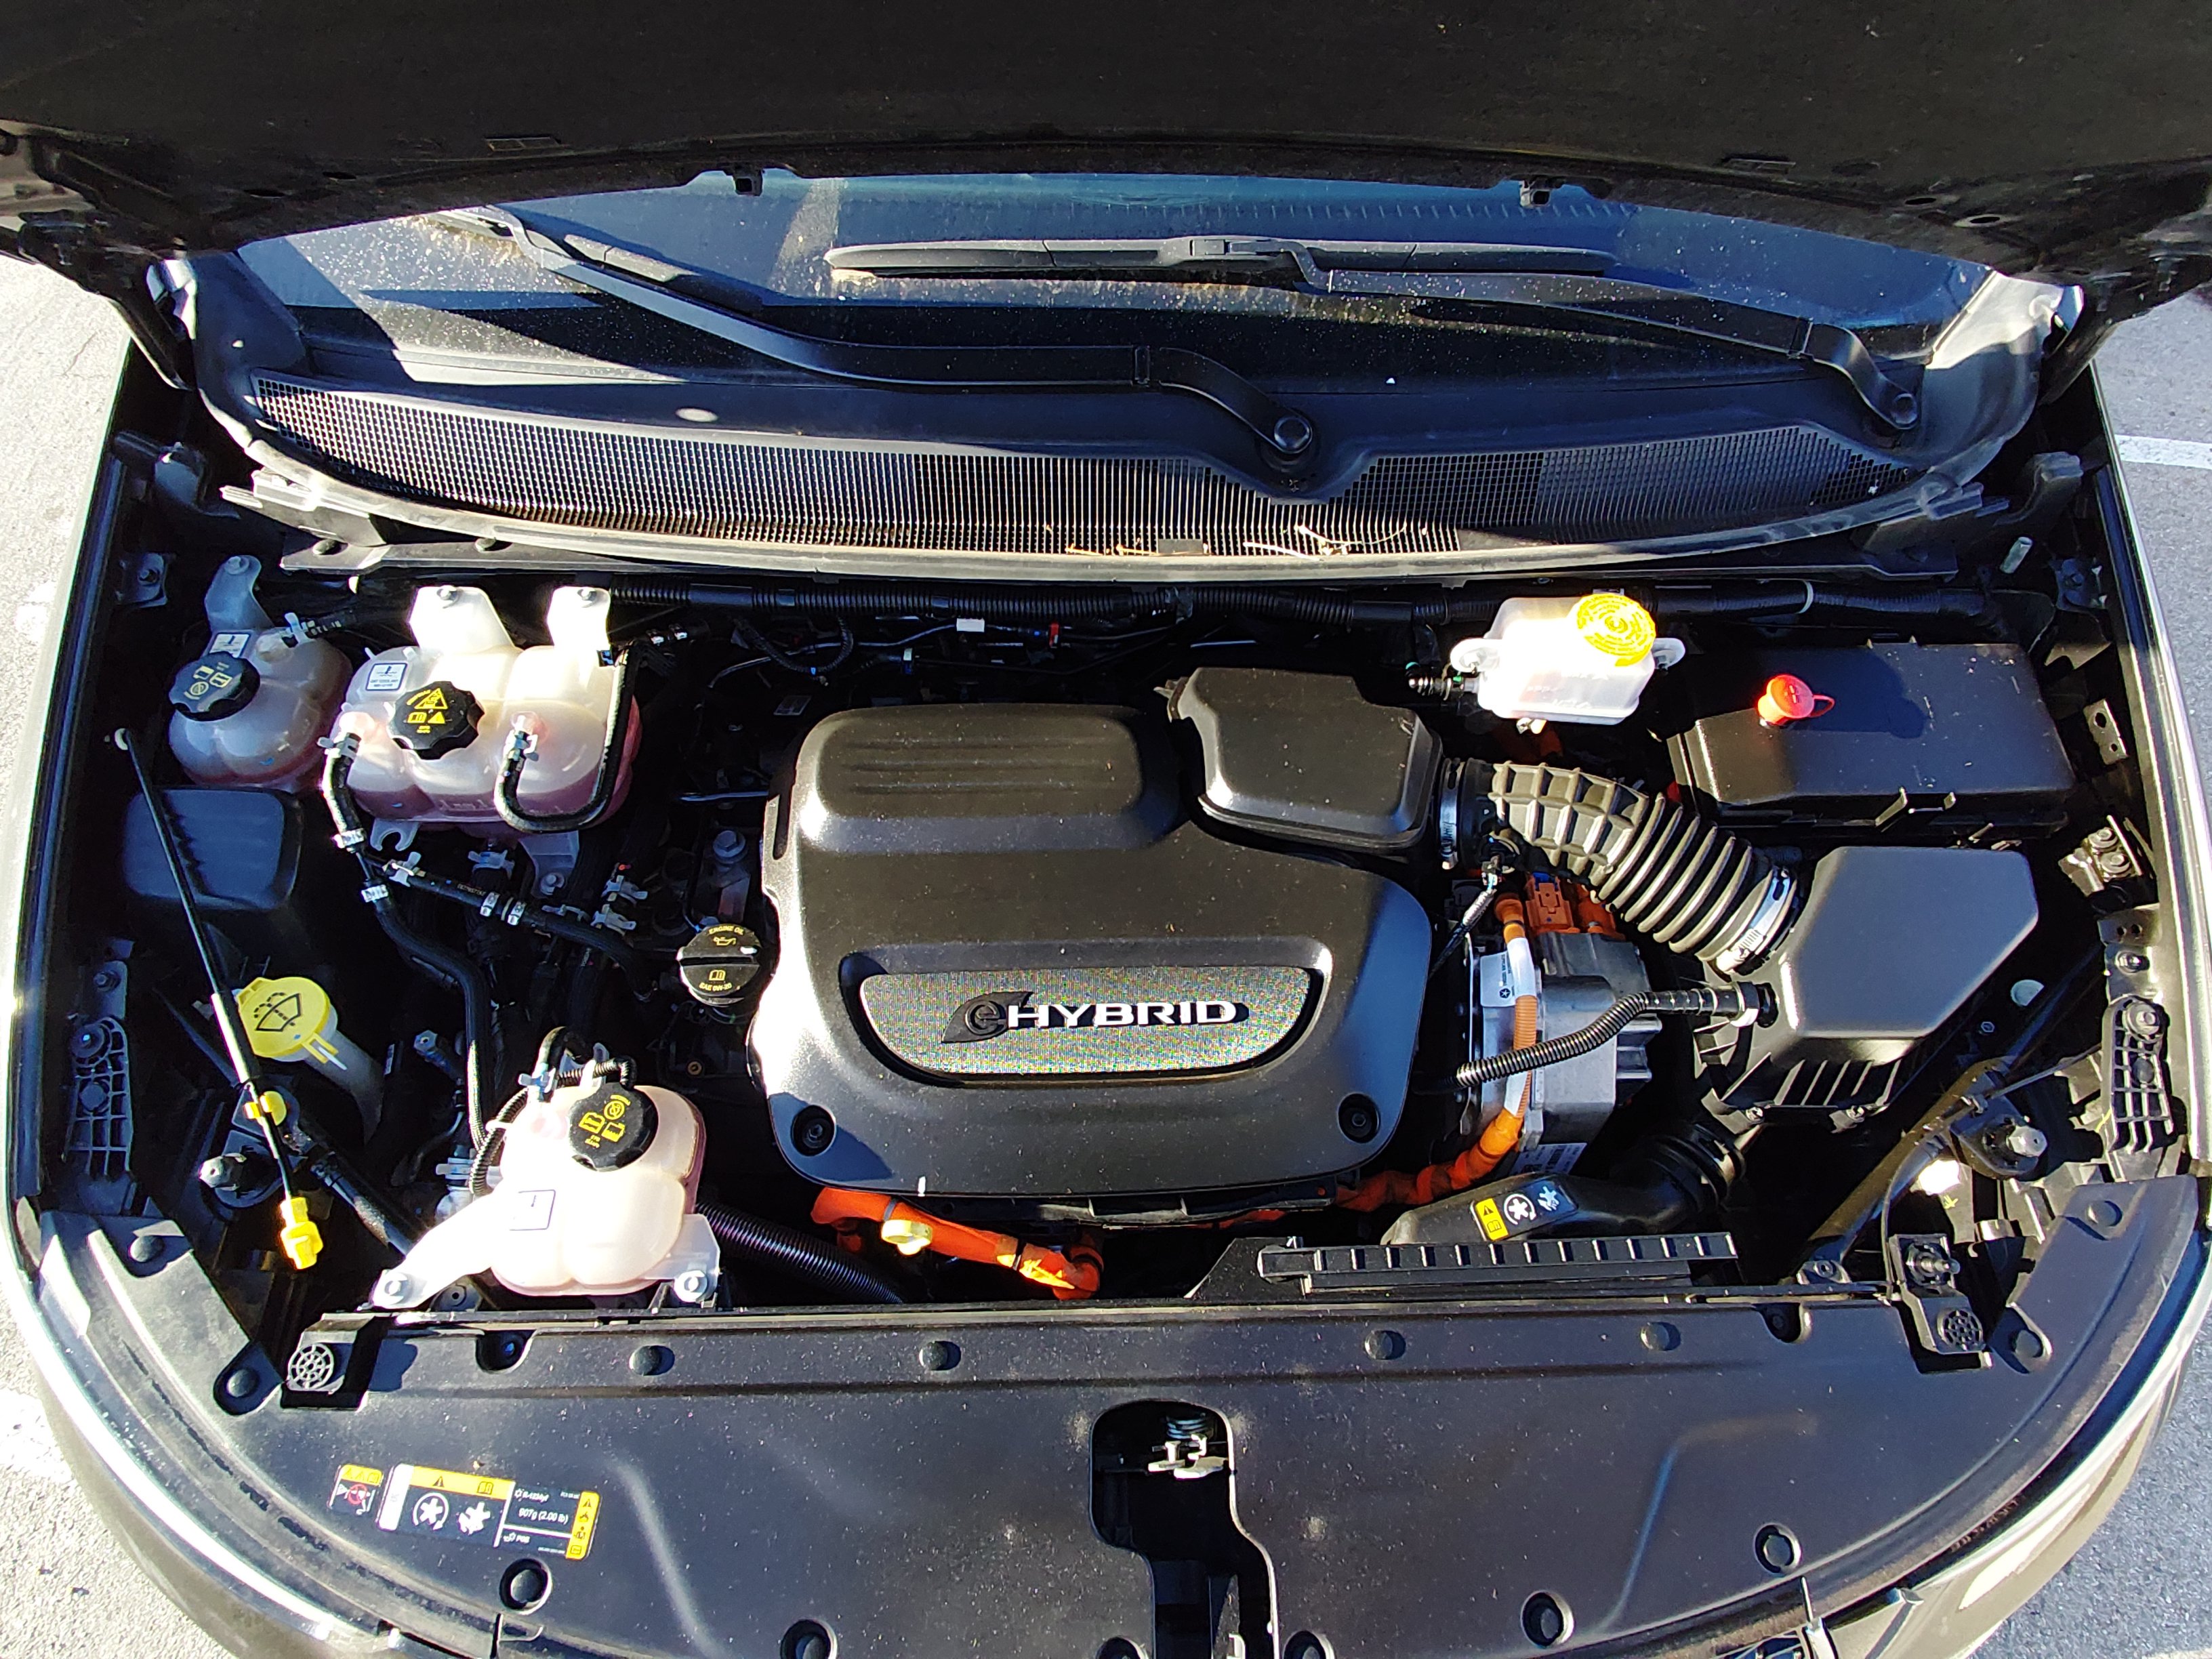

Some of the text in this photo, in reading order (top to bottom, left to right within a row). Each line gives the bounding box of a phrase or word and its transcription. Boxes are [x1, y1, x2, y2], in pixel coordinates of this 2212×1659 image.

[708, 925, 745, 935] ENGINE OIL
[699, 982, 733, 991] SAE 0W-20
